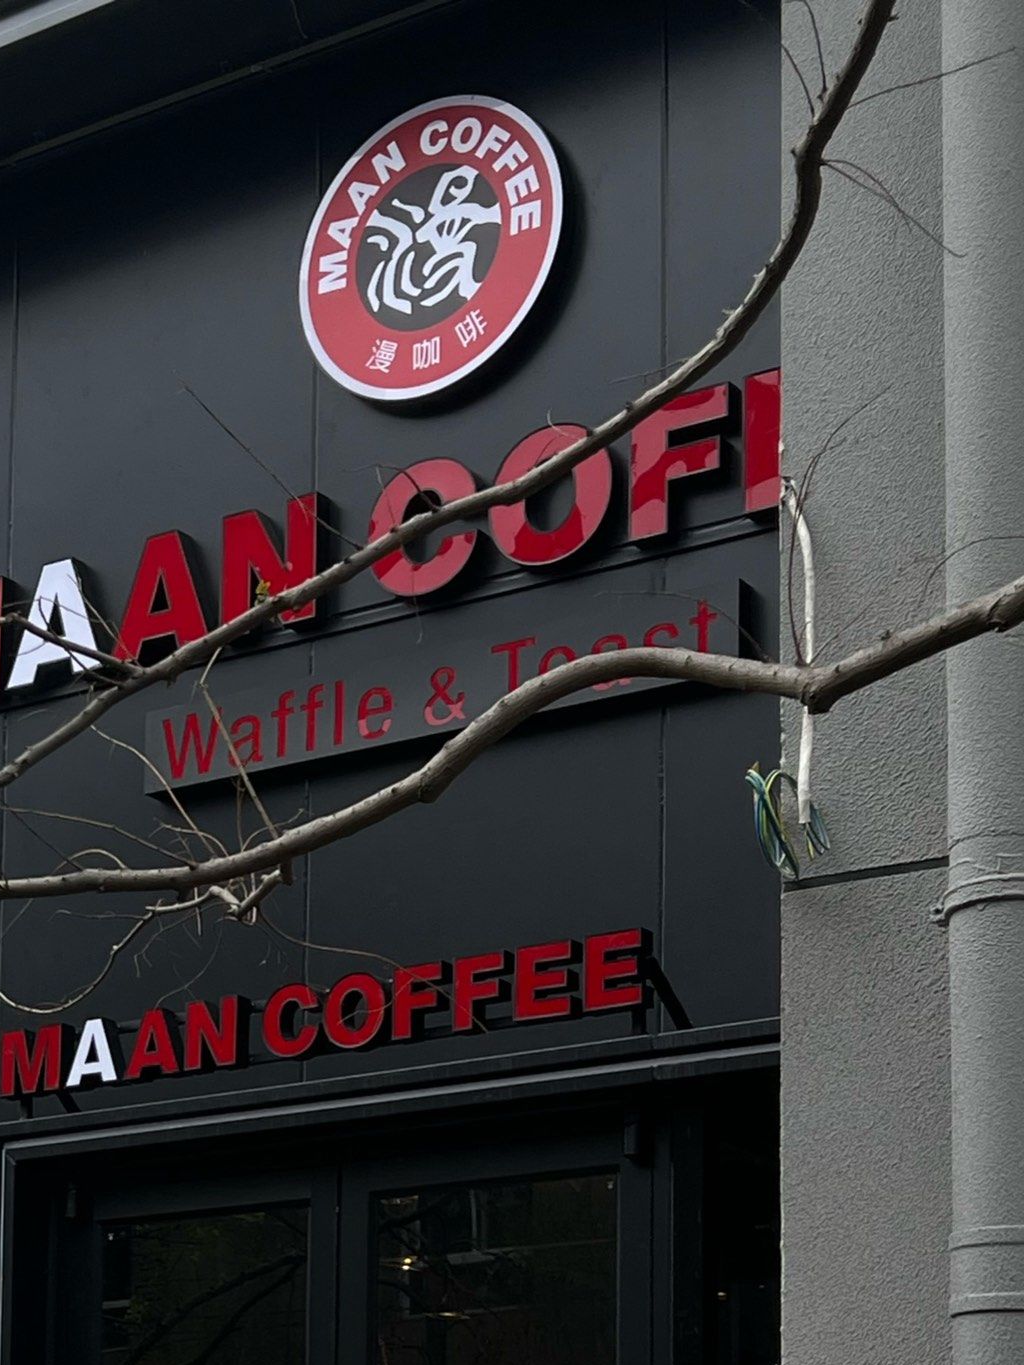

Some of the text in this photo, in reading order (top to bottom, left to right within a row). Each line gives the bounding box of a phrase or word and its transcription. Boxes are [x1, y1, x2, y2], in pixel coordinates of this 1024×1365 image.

[317, 117, 542, 294] MAAN COFFEE
[365, 308, 488, 374] 漫咖啡
[162, 679, 394, 780] Waffle
[423, 665, 467, 726] &
[262, 927, 642, 1058] COFFEE
